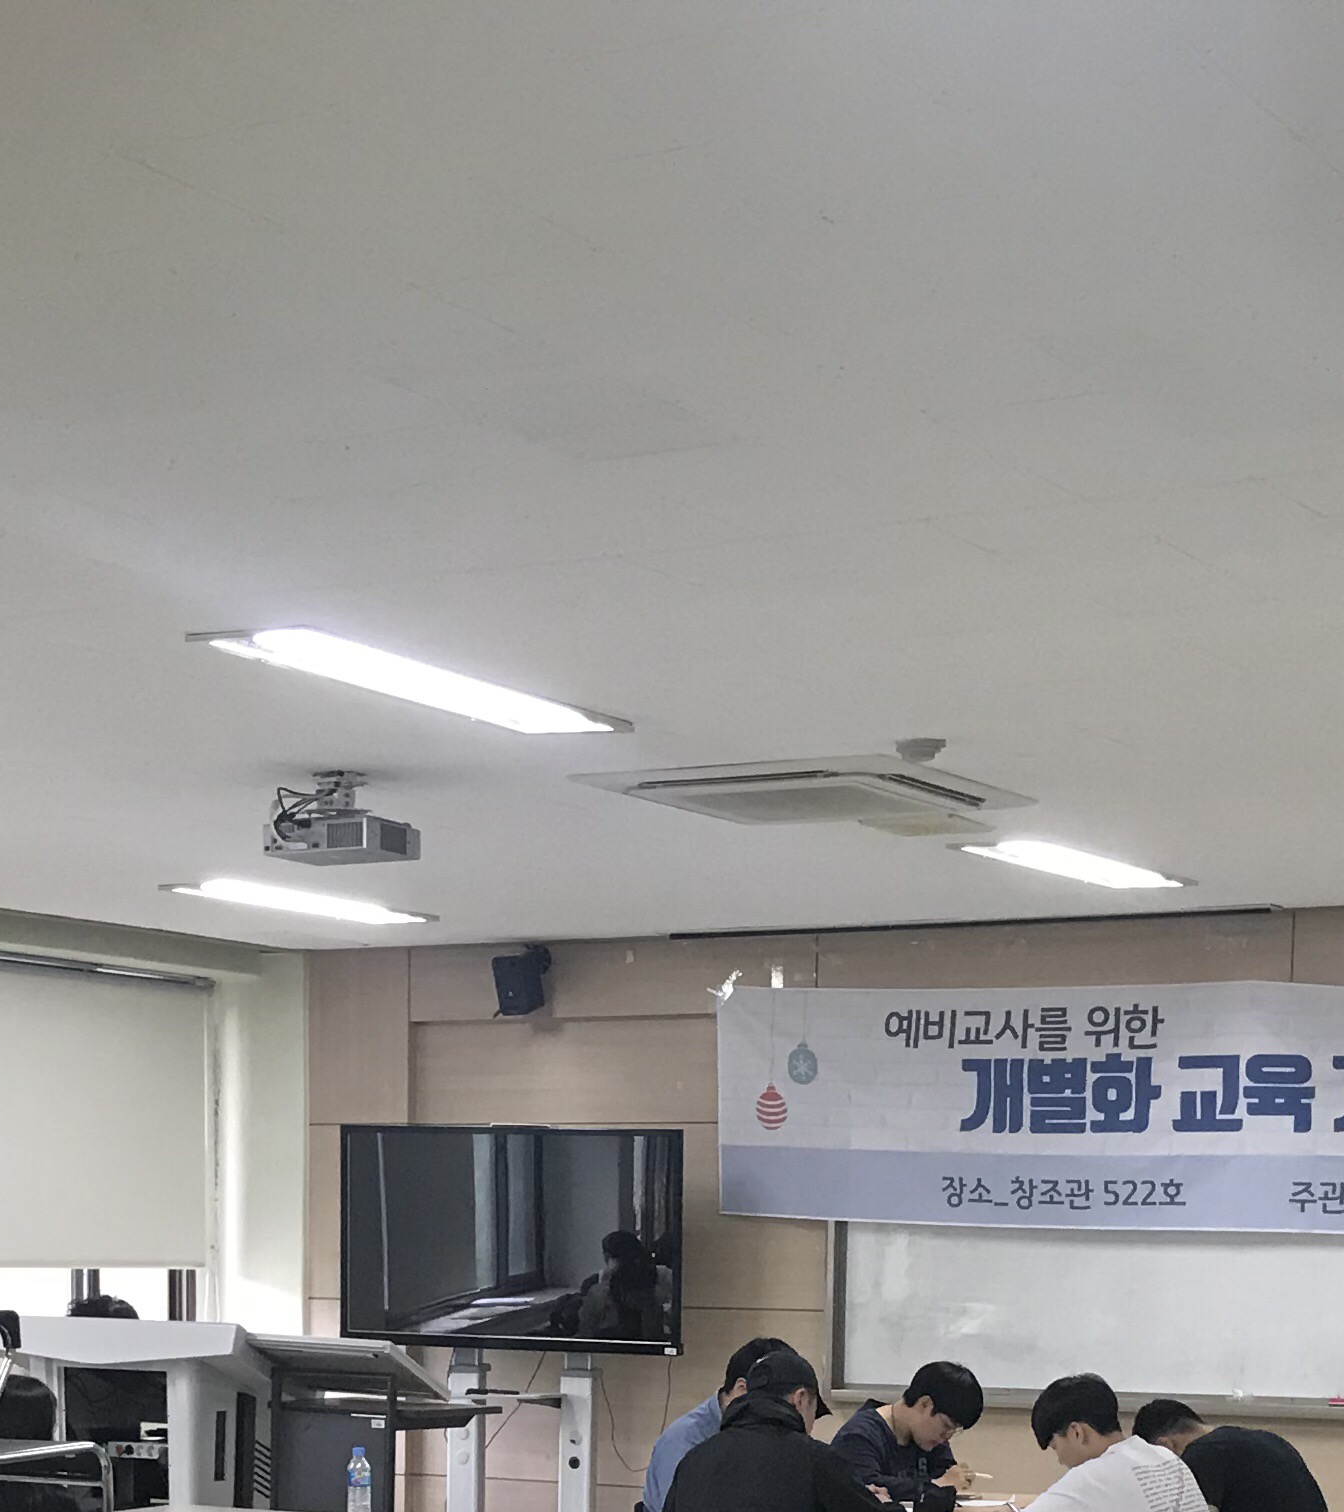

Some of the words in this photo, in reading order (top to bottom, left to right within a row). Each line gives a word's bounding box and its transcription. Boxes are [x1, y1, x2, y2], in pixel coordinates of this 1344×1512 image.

[884, 1006, 1072, 1052] 예비교사를
[1084, 1003, 1165, 1051] 위한
[959, 1052, 1162, 1134] 개별화
[1171, 1053, 1317, 1134] 교육
[940, 1176, 1095, 1211] 장소_창조관
[1102, 1178, 1188, 1208] 522호
